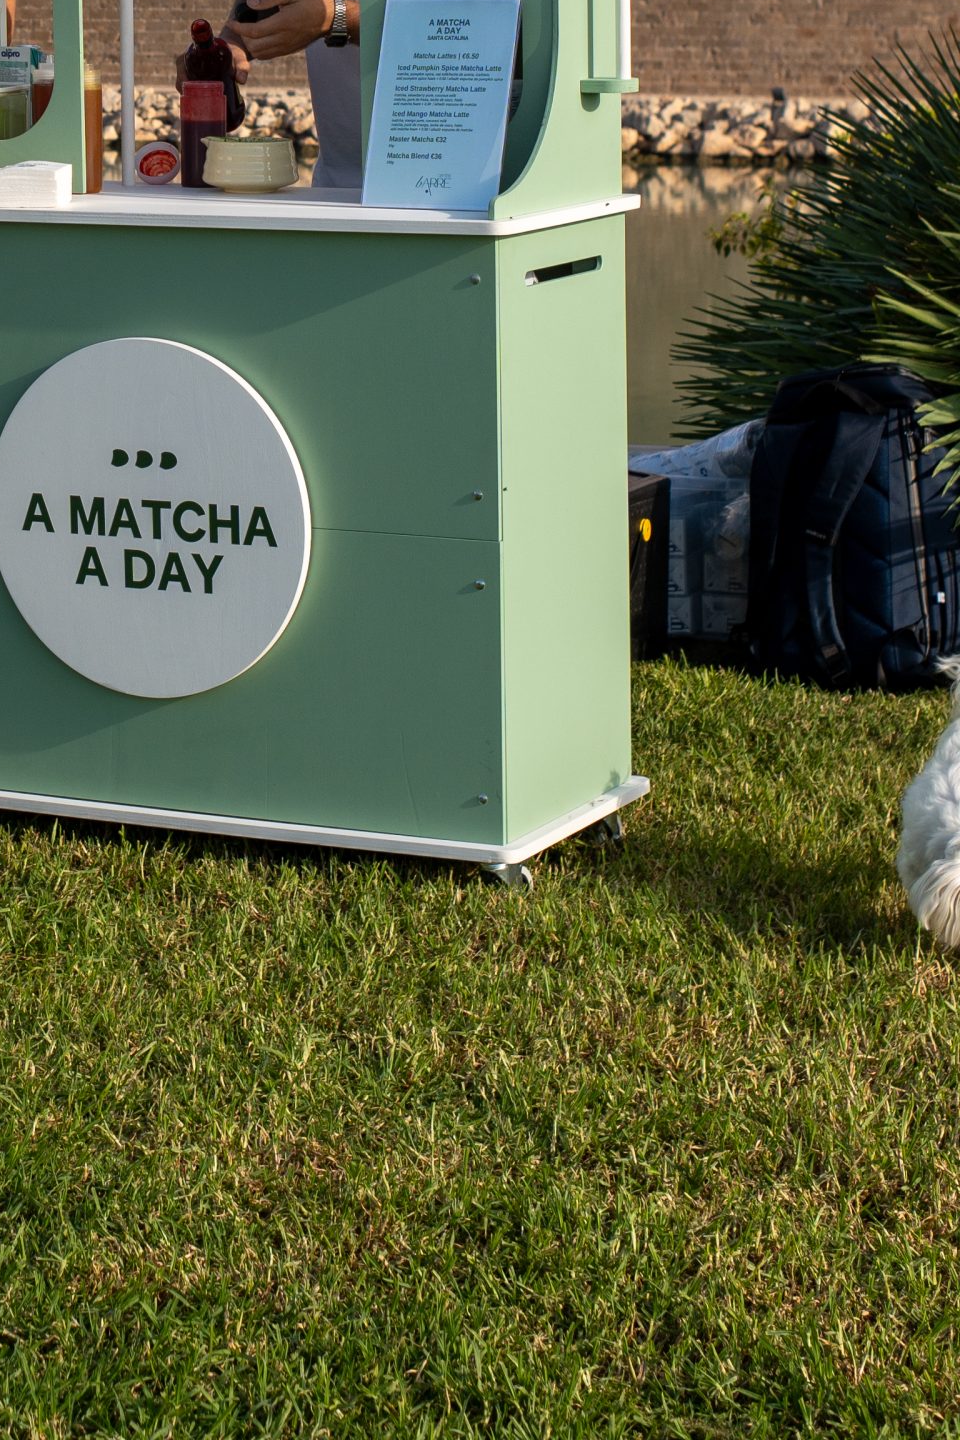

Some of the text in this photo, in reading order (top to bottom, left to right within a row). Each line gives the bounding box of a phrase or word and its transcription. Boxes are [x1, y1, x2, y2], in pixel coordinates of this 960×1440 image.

[1, 49, 20, 59] alpro
[22, 492, 278, 547] A MATCHA
[75, 546, 224, 594] A DAY
